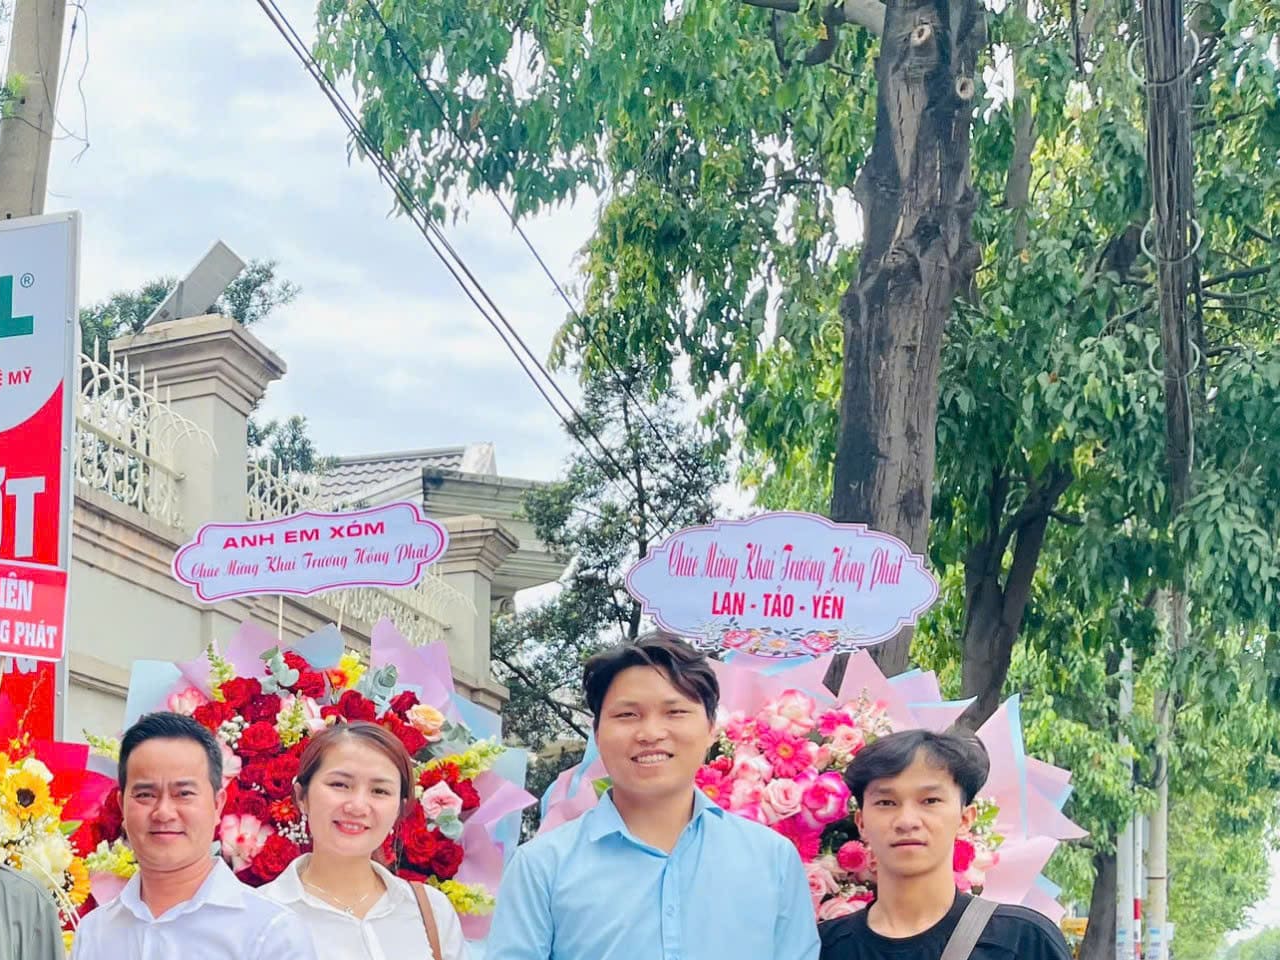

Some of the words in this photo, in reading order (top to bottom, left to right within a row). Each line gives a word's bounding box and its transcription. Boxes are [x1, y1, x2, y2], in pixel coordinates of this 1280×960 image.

[8, 366, 33, 385] MỸ
[223, 533, 274, 549] ANH
[284, 528, 320, 544] EM
[329, 520, 385, 539] XÓM
[668, 540, 699, 577] Chúc
[741, 542, 777, 580] Khai
[869, 547, 904, 592] Phát
[711, 591, 746, 616] LAN
[762, 584, 795, 618] TẢO
[812, 587, 845, 620] YẾN
[14, 619, 58, 649] PHÁT
